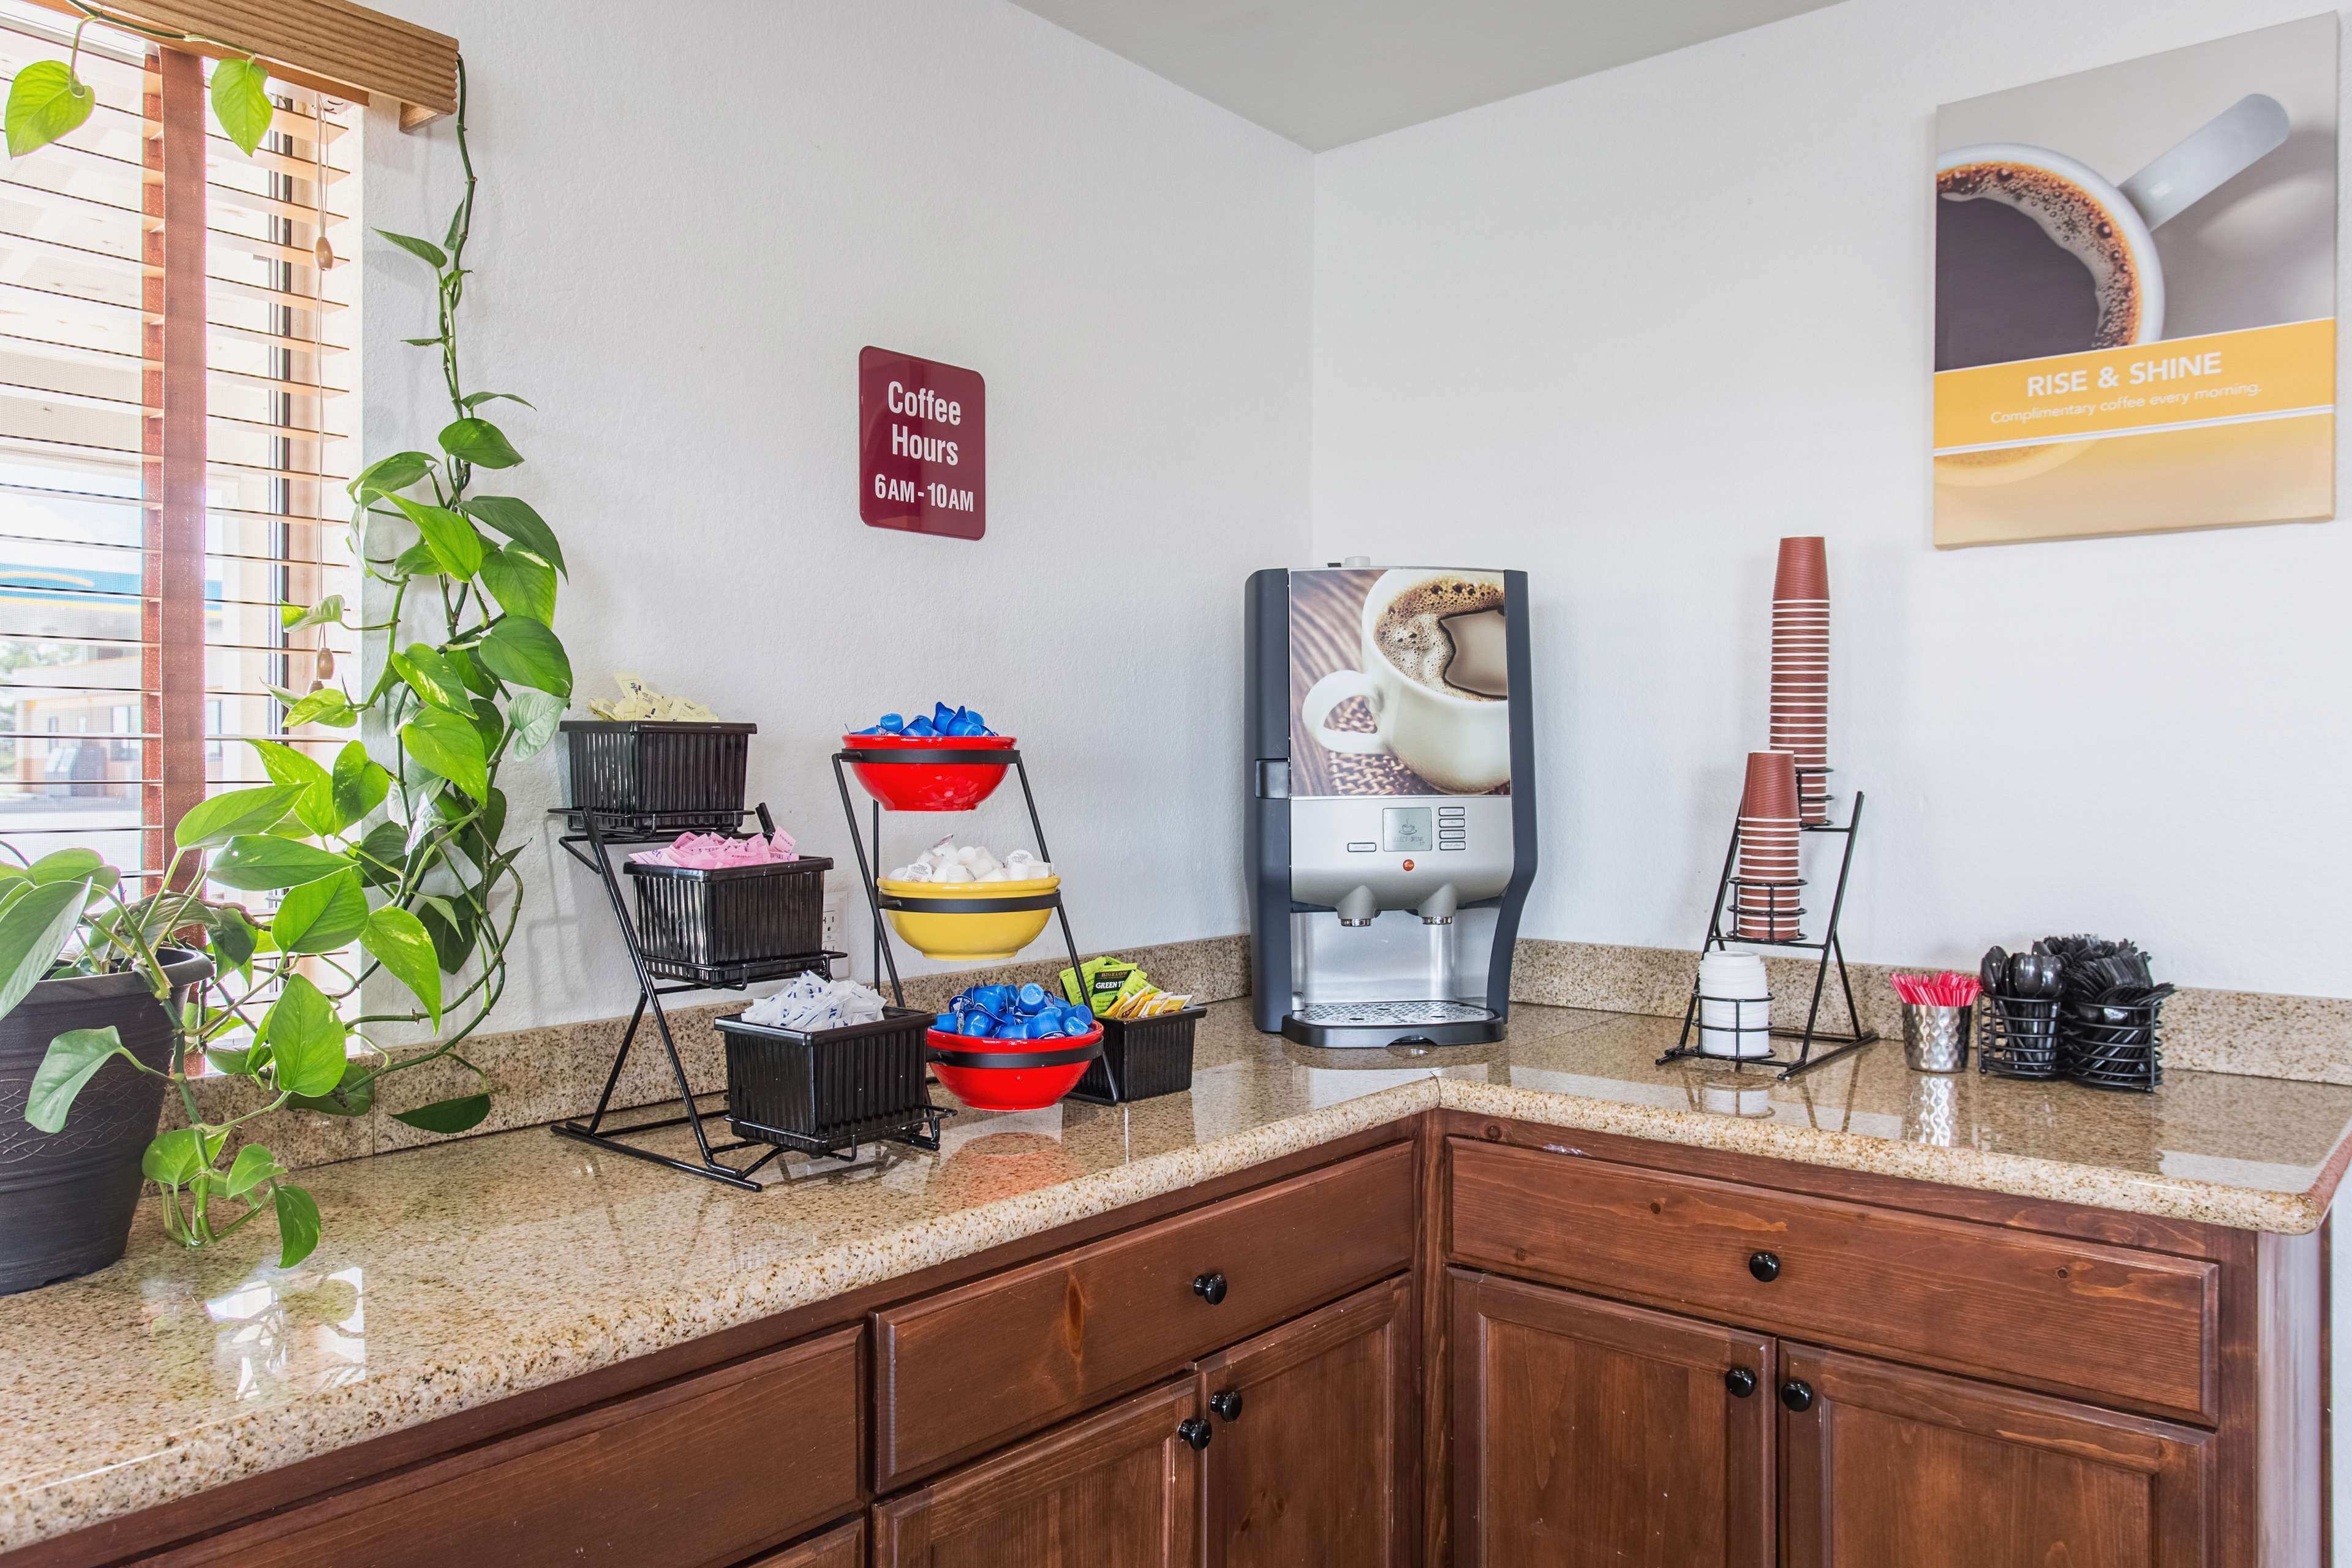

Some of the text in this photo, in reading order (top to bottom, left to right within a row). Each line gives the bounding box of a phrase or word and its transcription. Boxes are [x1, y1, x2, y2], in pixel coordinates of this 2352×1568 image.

[2027, 352, 2223, 397] RISE & SHINE
[888, 381, 961, 426] Coffee
[1991, 383, 2263, 424] Complimentary coffee every morning.
[892, 424, 959, 466] Hours
